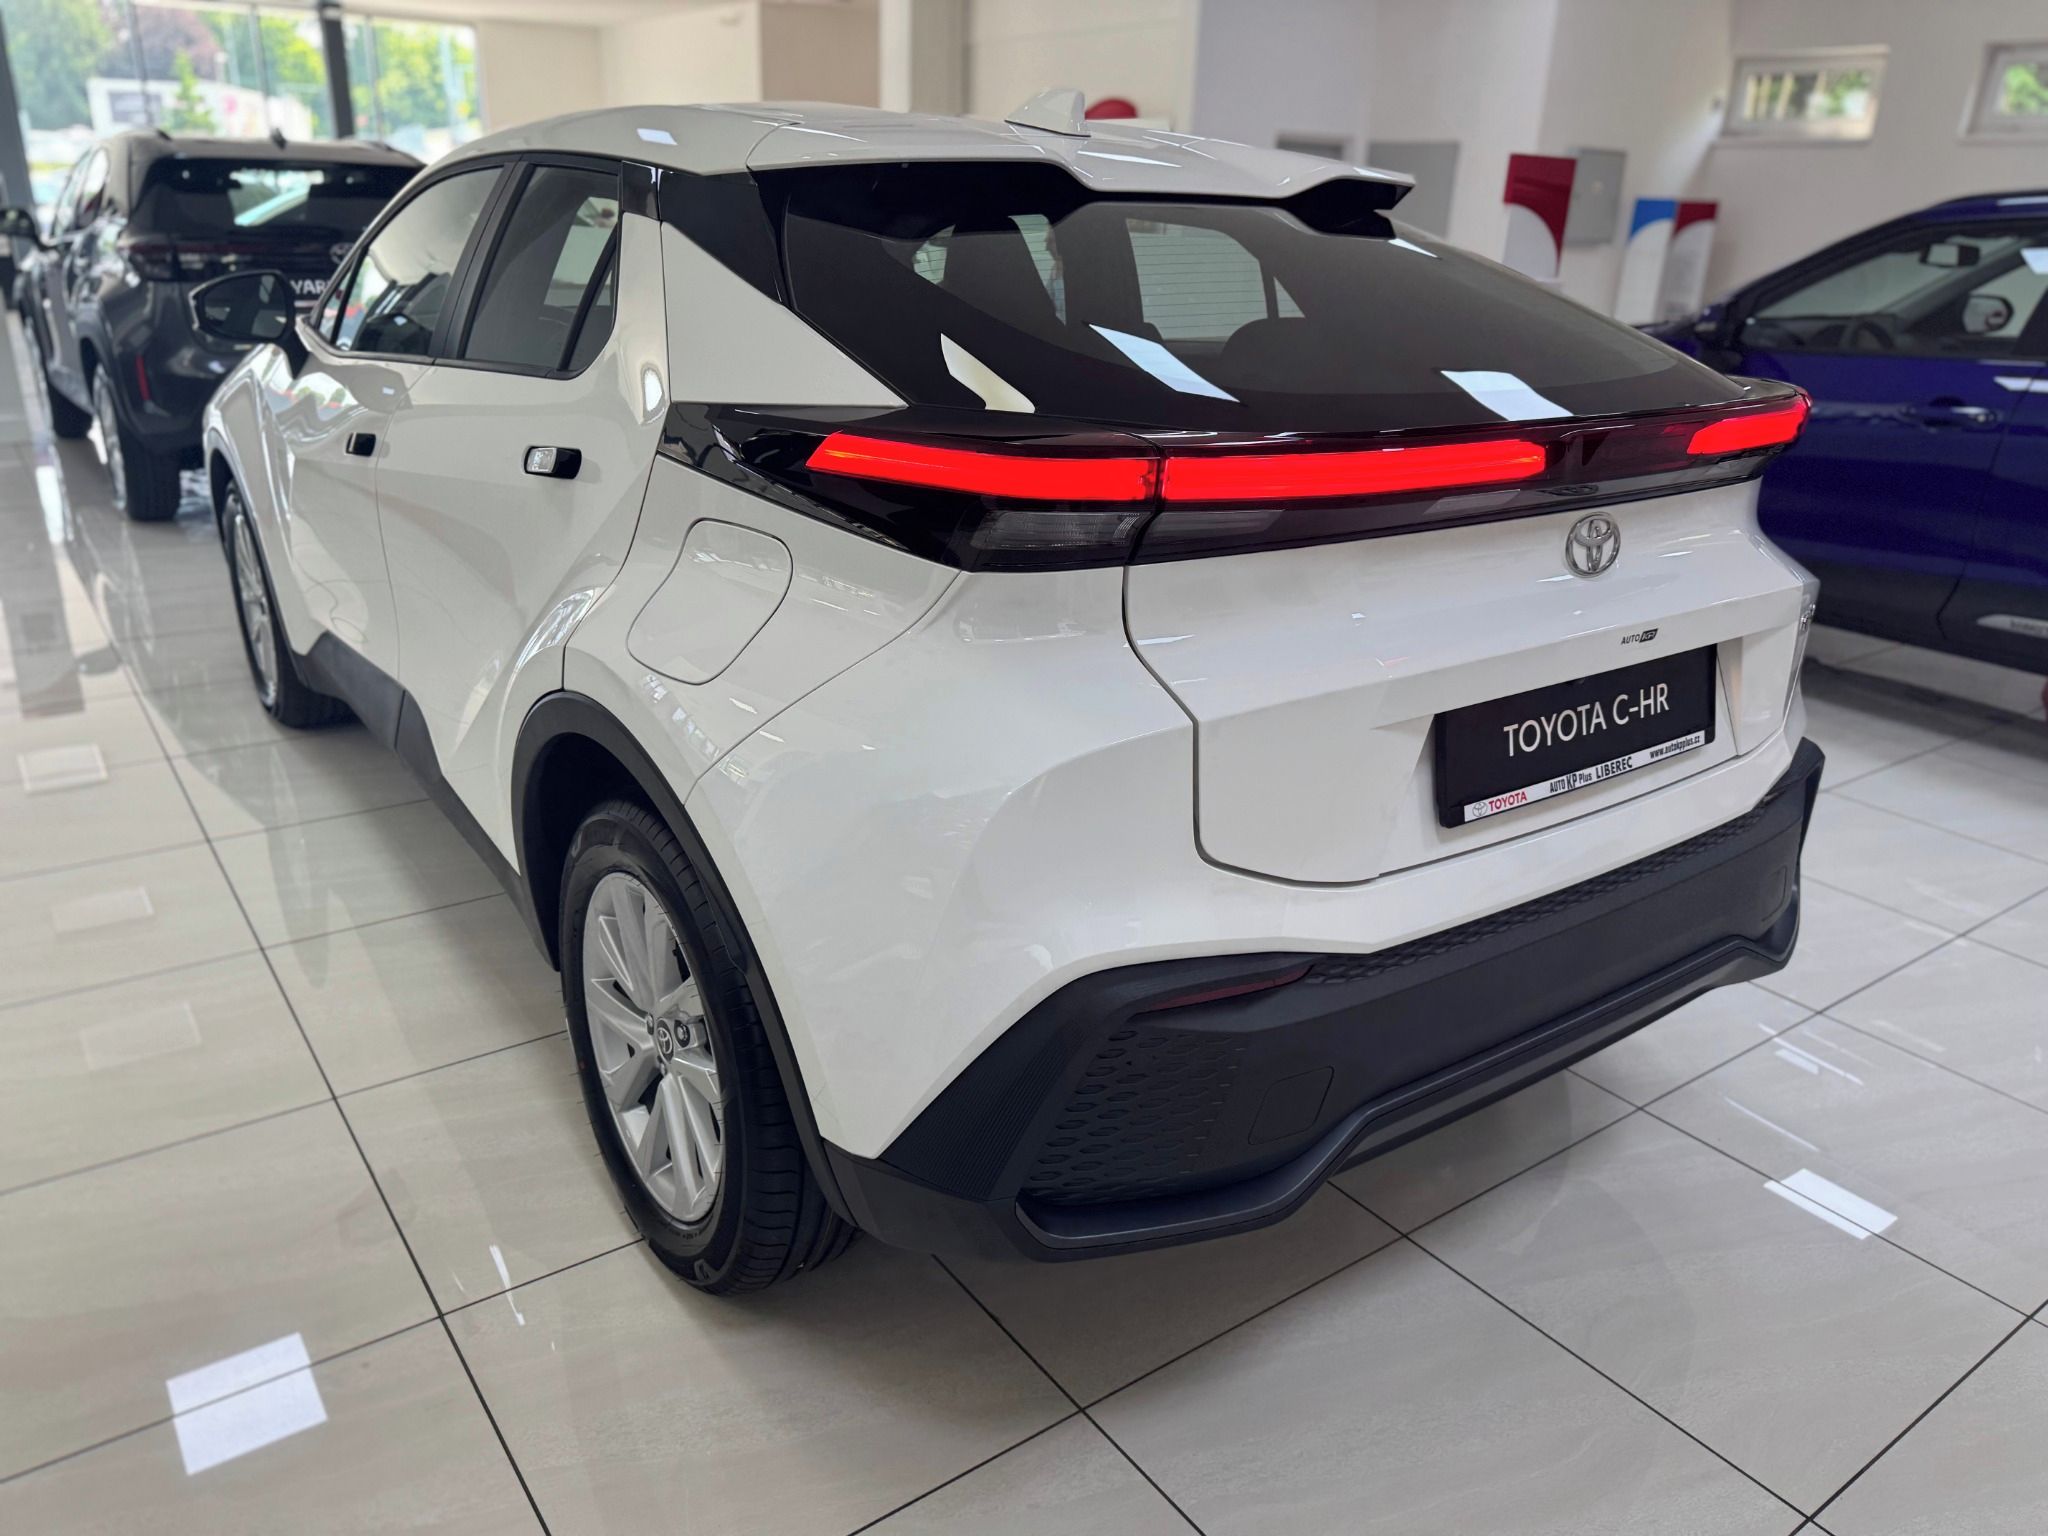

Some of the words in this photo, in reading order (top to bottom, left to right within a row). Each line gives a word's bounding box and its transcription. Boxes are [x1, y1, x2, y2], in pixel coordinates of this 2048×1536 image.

[1503, 701, 1607, 757] TOYOTA
[1612, 683, 1670, 725] C-HR
[1549, 778, 1566, 793] AUTO
[1565, 773, 1579, 790] KP
[1578, 771, 1593, 784] Plus
[1595, 756, 1633, 779] LIBEREC
[1488, 791, 1528, 812] TOYOTA
